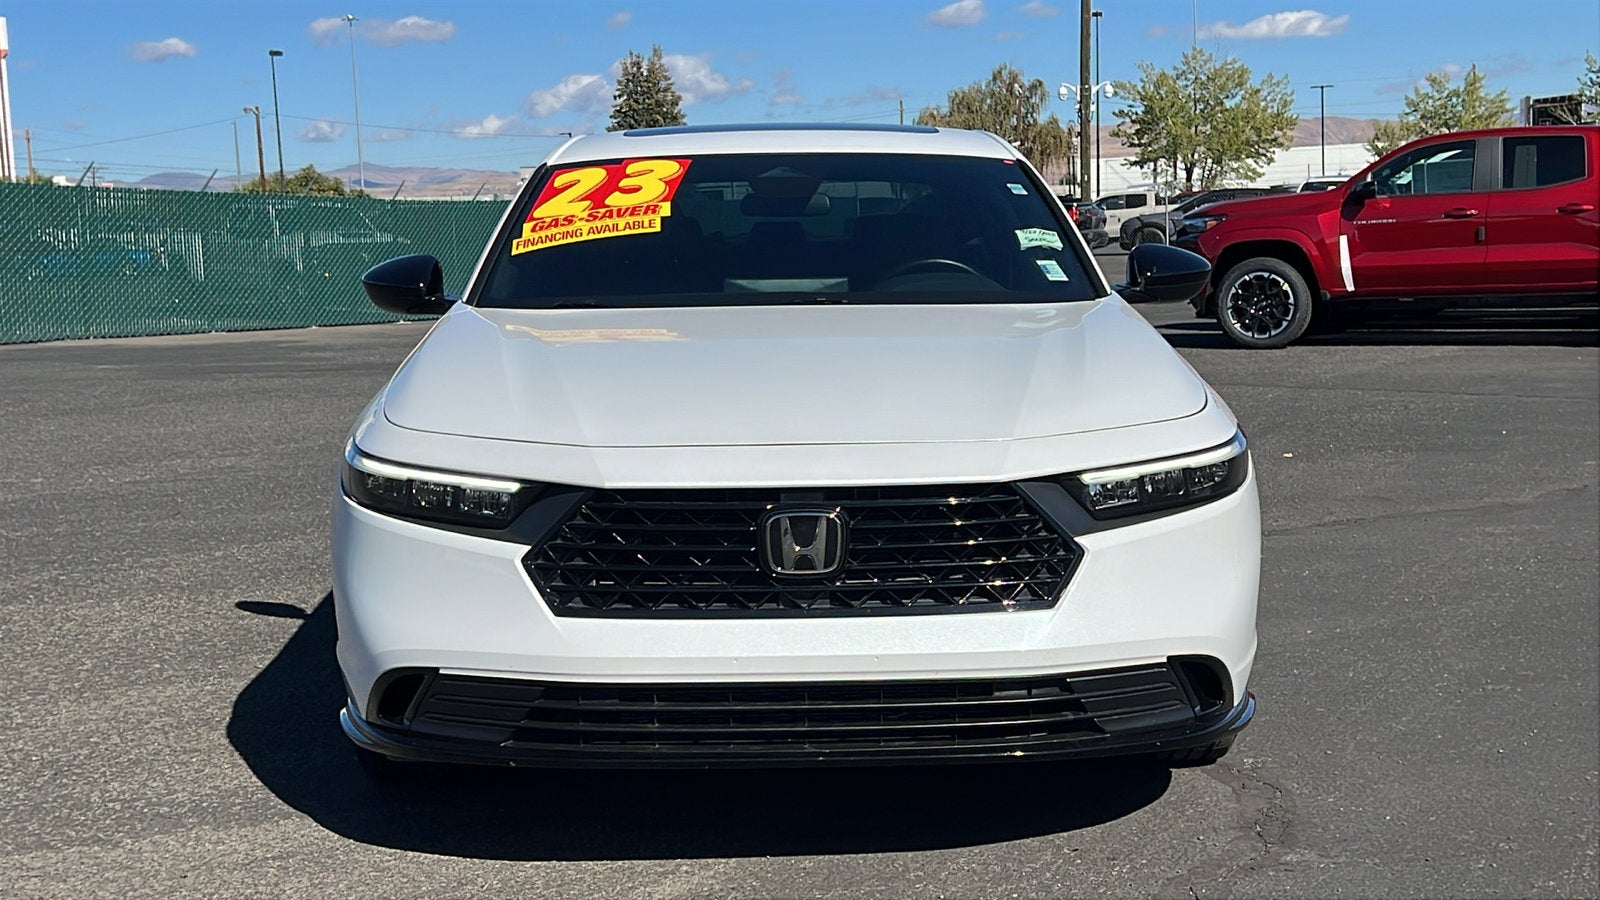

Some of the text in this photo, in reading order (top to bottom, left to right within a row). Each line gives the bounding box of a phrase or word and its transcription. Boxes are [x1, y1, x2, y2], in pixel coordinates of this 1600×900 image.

[532, 159, 684, 219] 23
[530, 204, 662, 233] GAS-SAVER
[515, 219, 657, 250] FINANCING AVAILABLE
